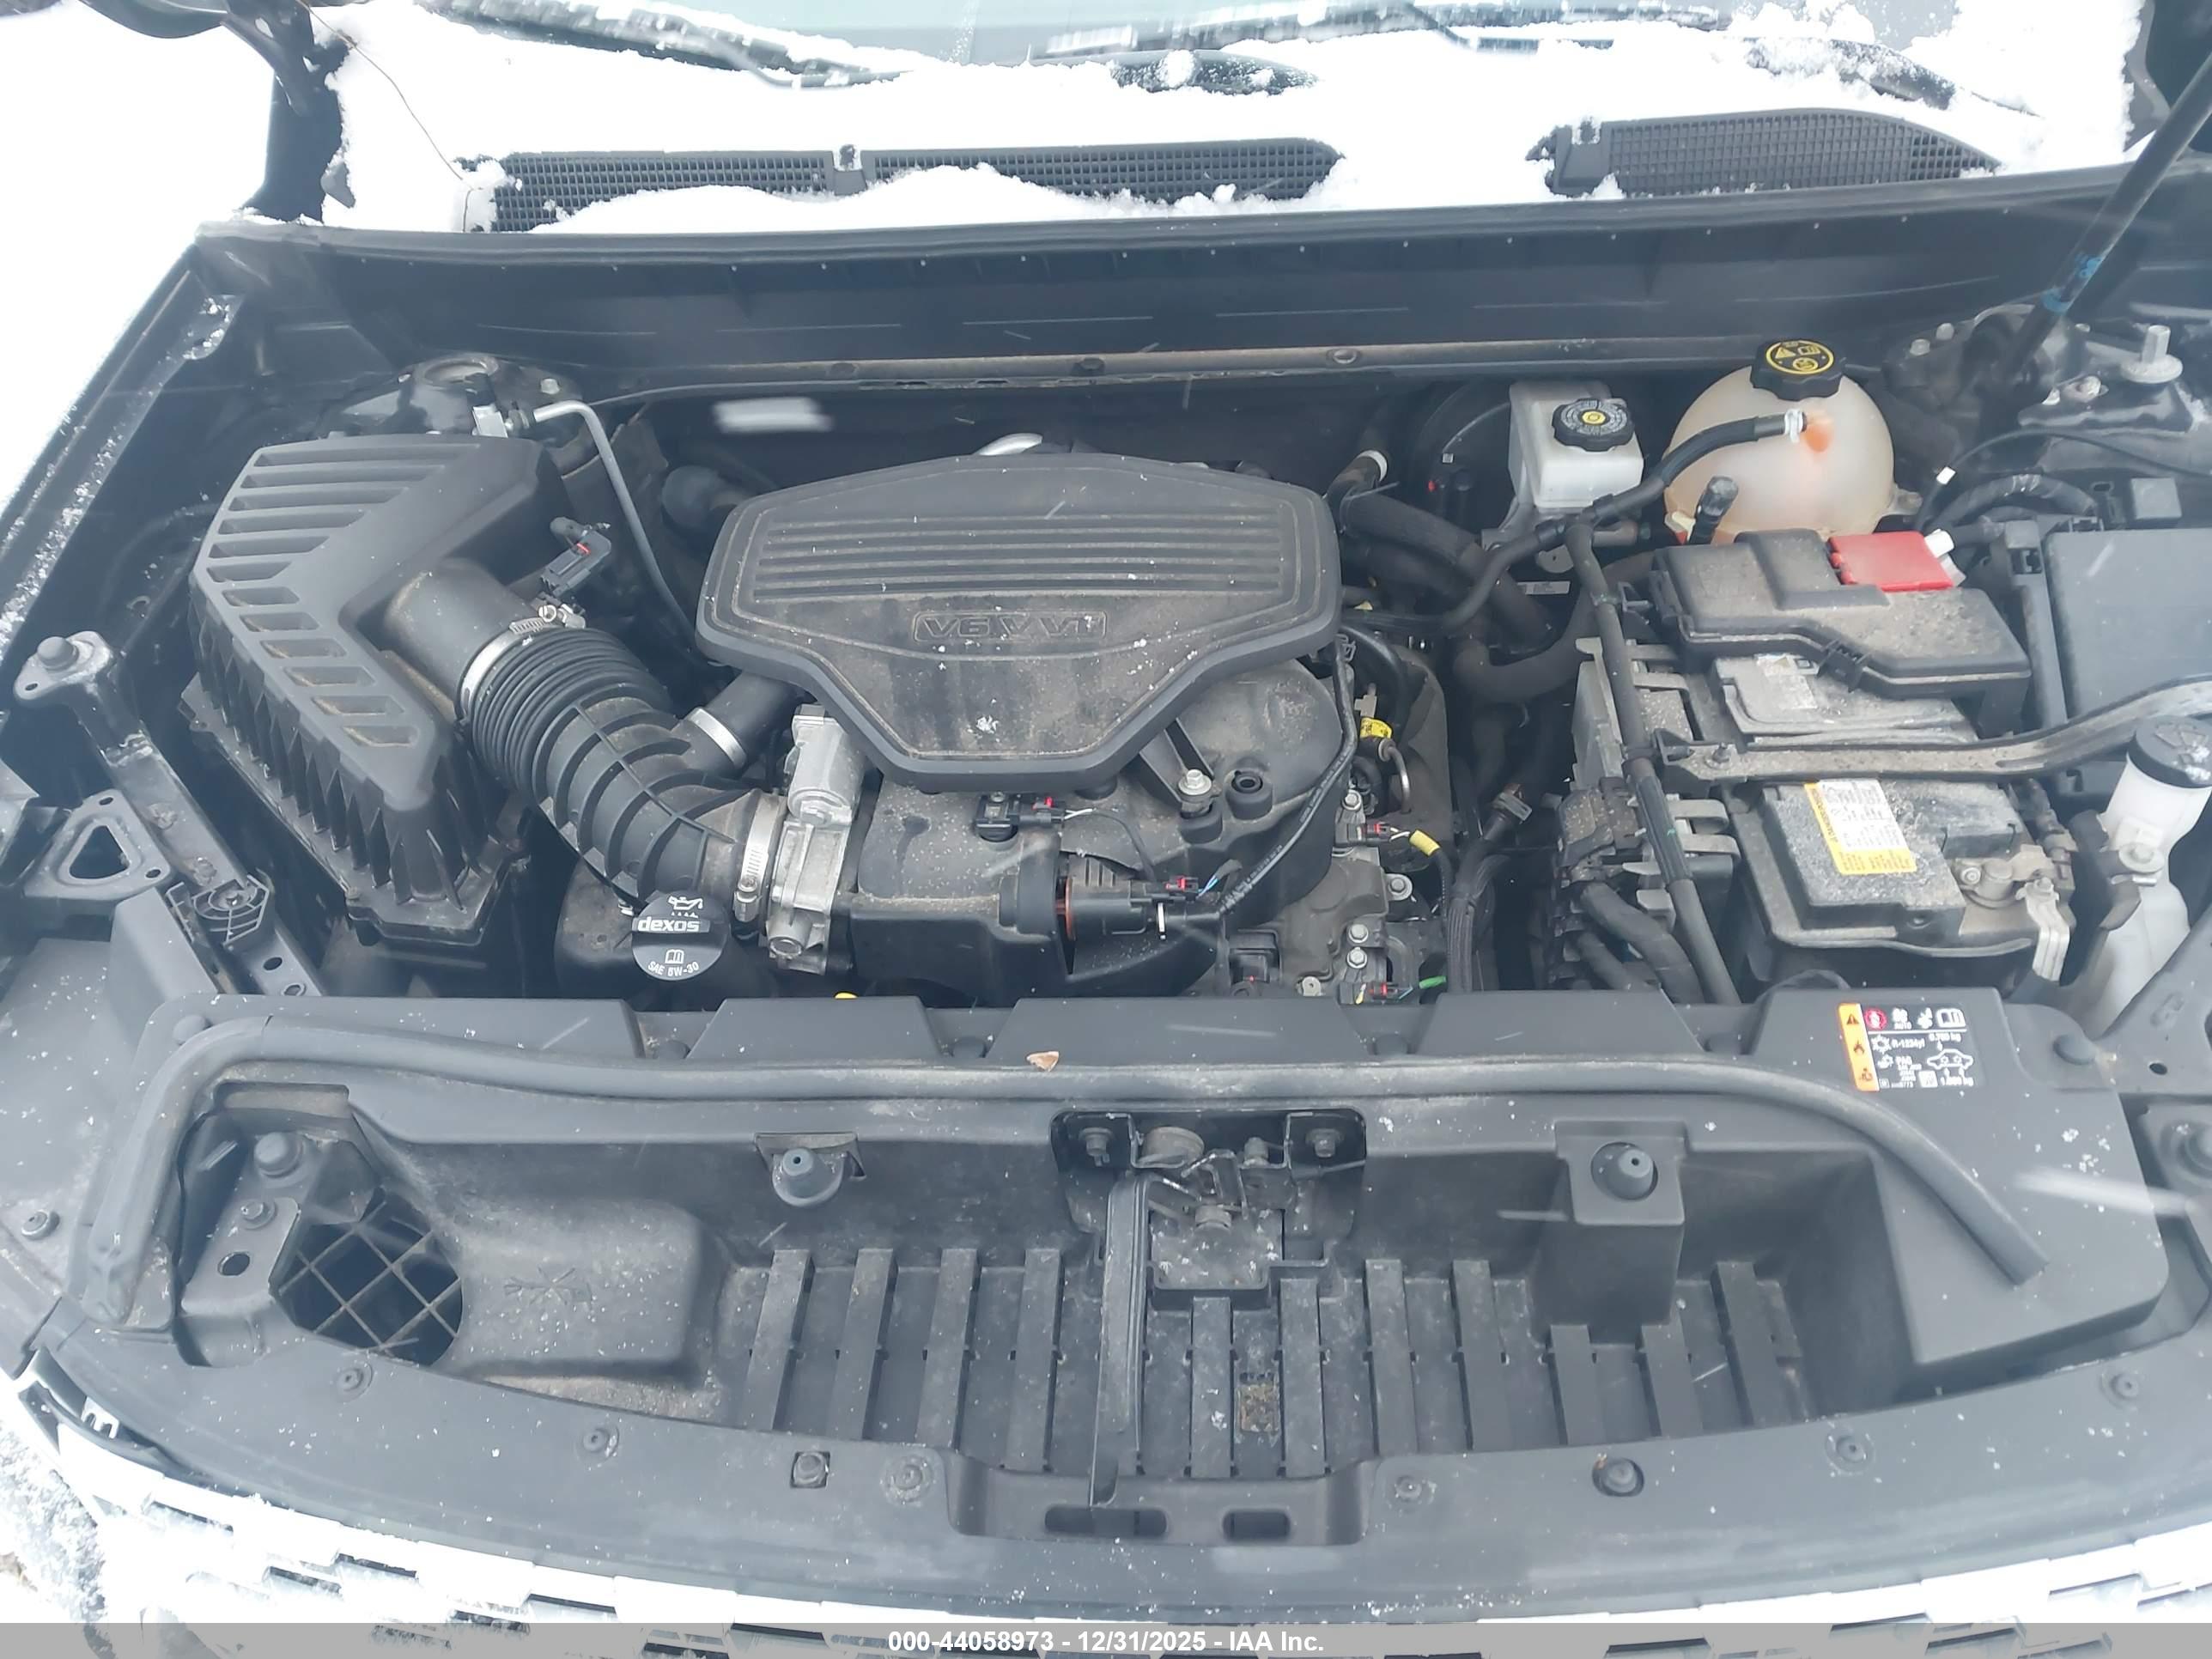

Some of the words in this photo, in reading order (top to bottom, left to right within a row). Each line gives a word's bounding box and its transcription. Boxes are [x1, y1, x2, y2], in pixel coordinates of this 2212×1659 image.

[921, 617, 990, 637] V6
[637, 916, 700, 932] dexos
[647, 961, 665, 975] SAE
